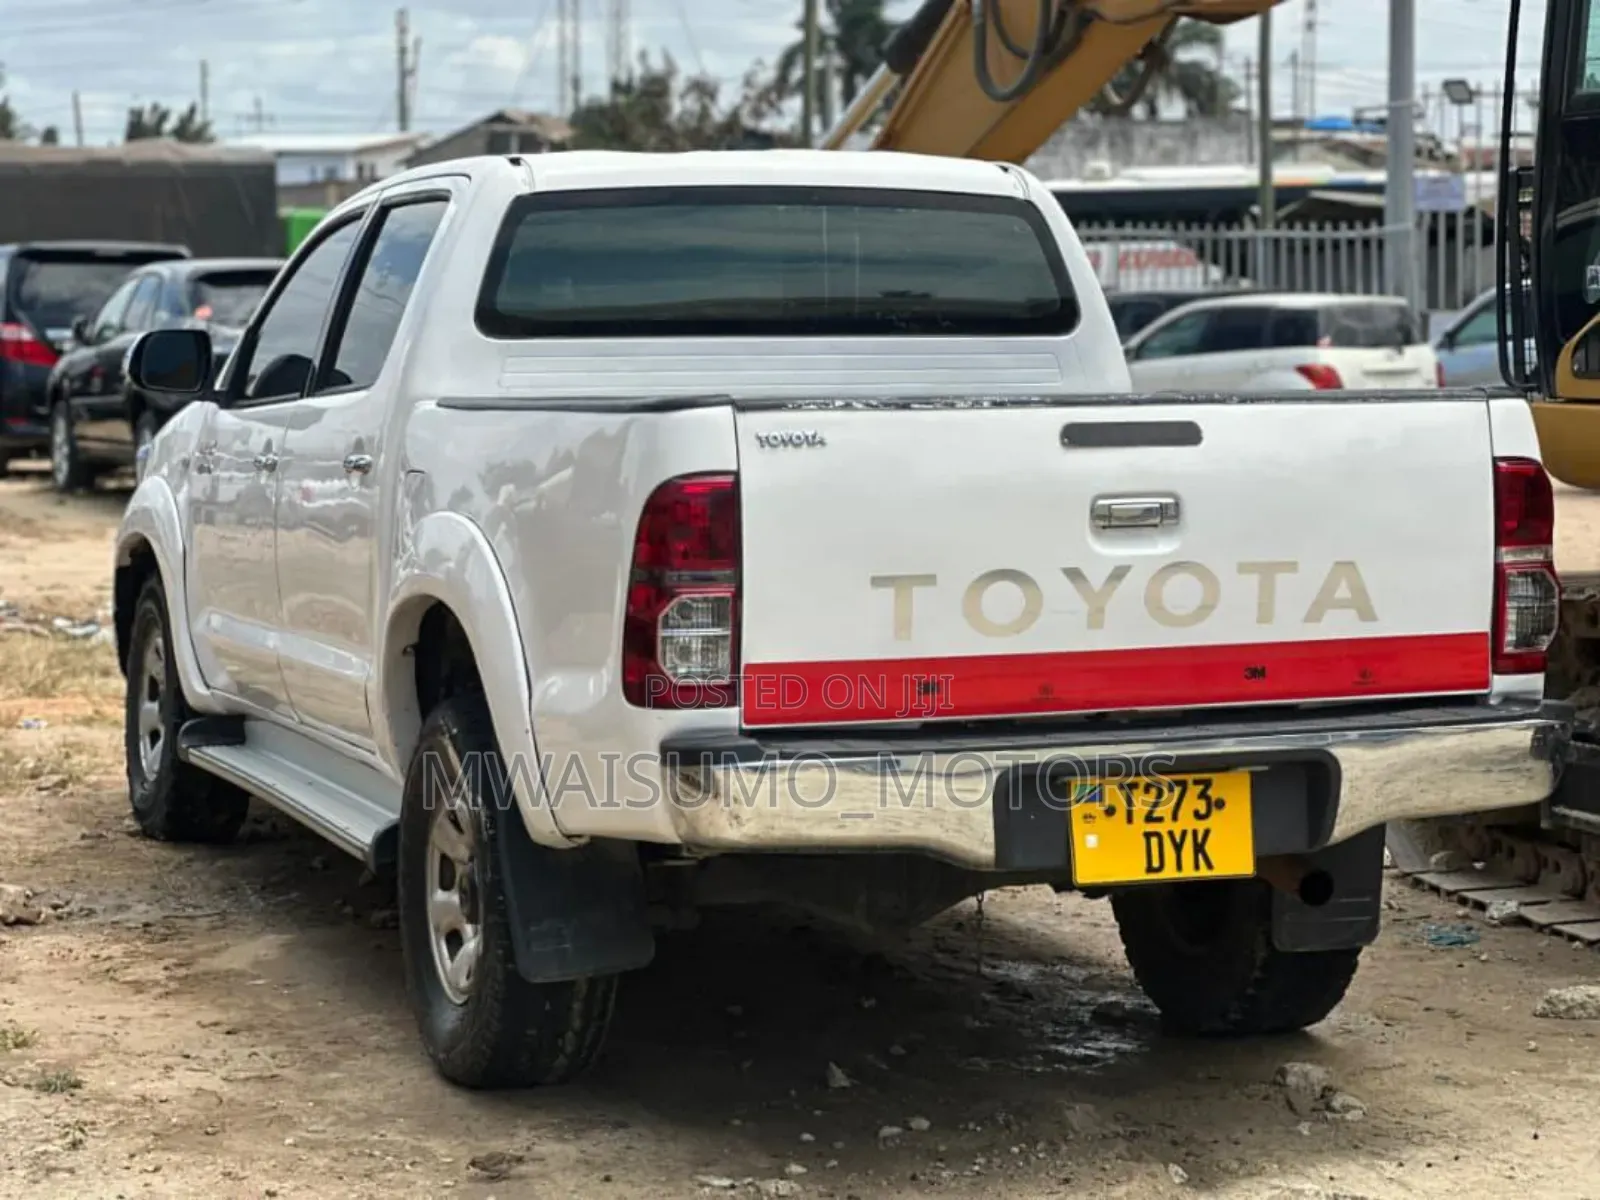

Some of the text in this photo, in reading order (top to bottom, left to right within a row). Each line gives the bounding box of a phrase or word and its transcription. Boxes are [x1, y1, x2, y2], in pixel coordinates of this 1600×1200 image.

[755, 429, 827, 449] TOYOTA
[870, 560, 1378, 641] TOYOTA
[1244, 665, 1267, 680] 3M
[1118, 778, 1216, 825] T273
[1143, 827, 1214, 874] DYK
